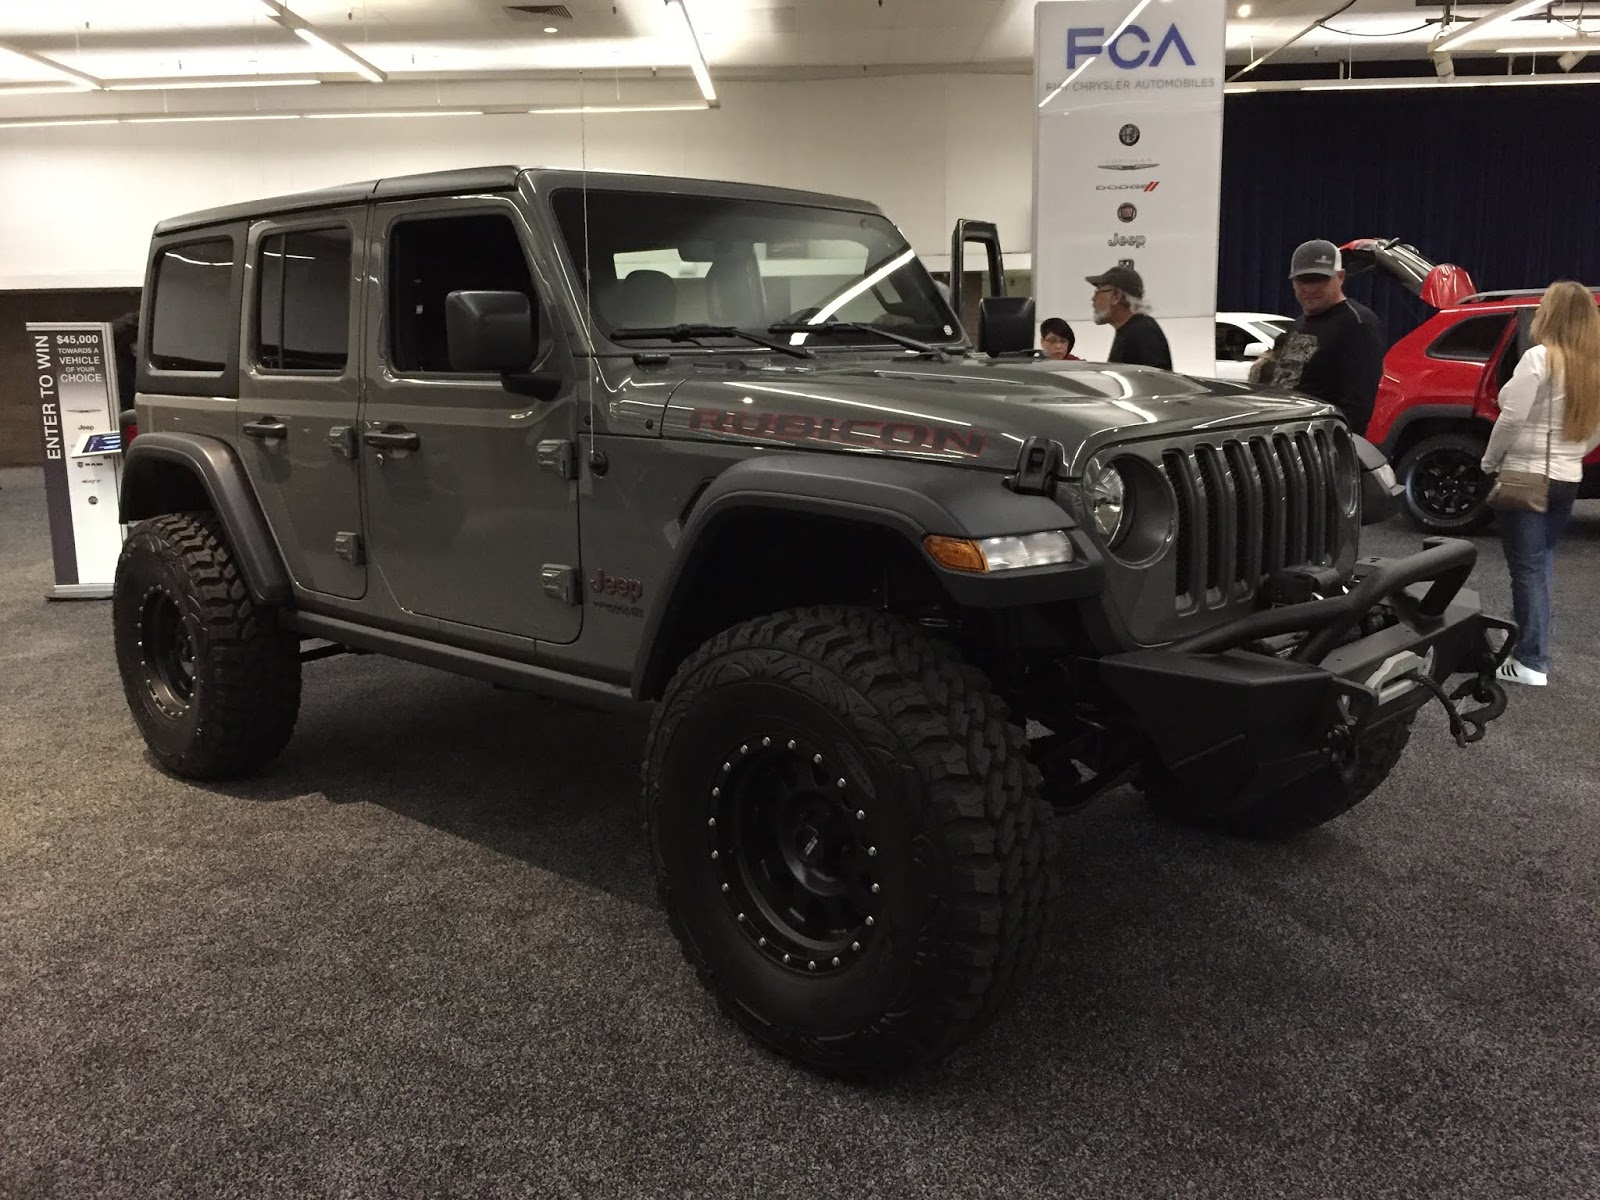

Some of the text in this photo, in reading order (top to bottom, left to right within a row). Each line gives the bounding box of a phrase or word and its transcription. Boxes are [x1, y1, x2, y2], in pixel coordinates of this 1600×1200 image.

[1066, 22, 1196, 70] FCA
[1072, 80, 1131, 92] CHRYSLER
[1134, 78, 1216, 91] AUTOMOBILES
[1107, 232, 1147, 249] Jeep
[56, 334, 99, 346] $45,000
[58, 356, 100, 365] VEHICLE
[60, 373, 102, 383] CHOICE
[34, 335, 62, 460] ENTER TO WIN
[689, 407, 988, 458] RUBICON
[589, 568, 643, 604] Jeep
